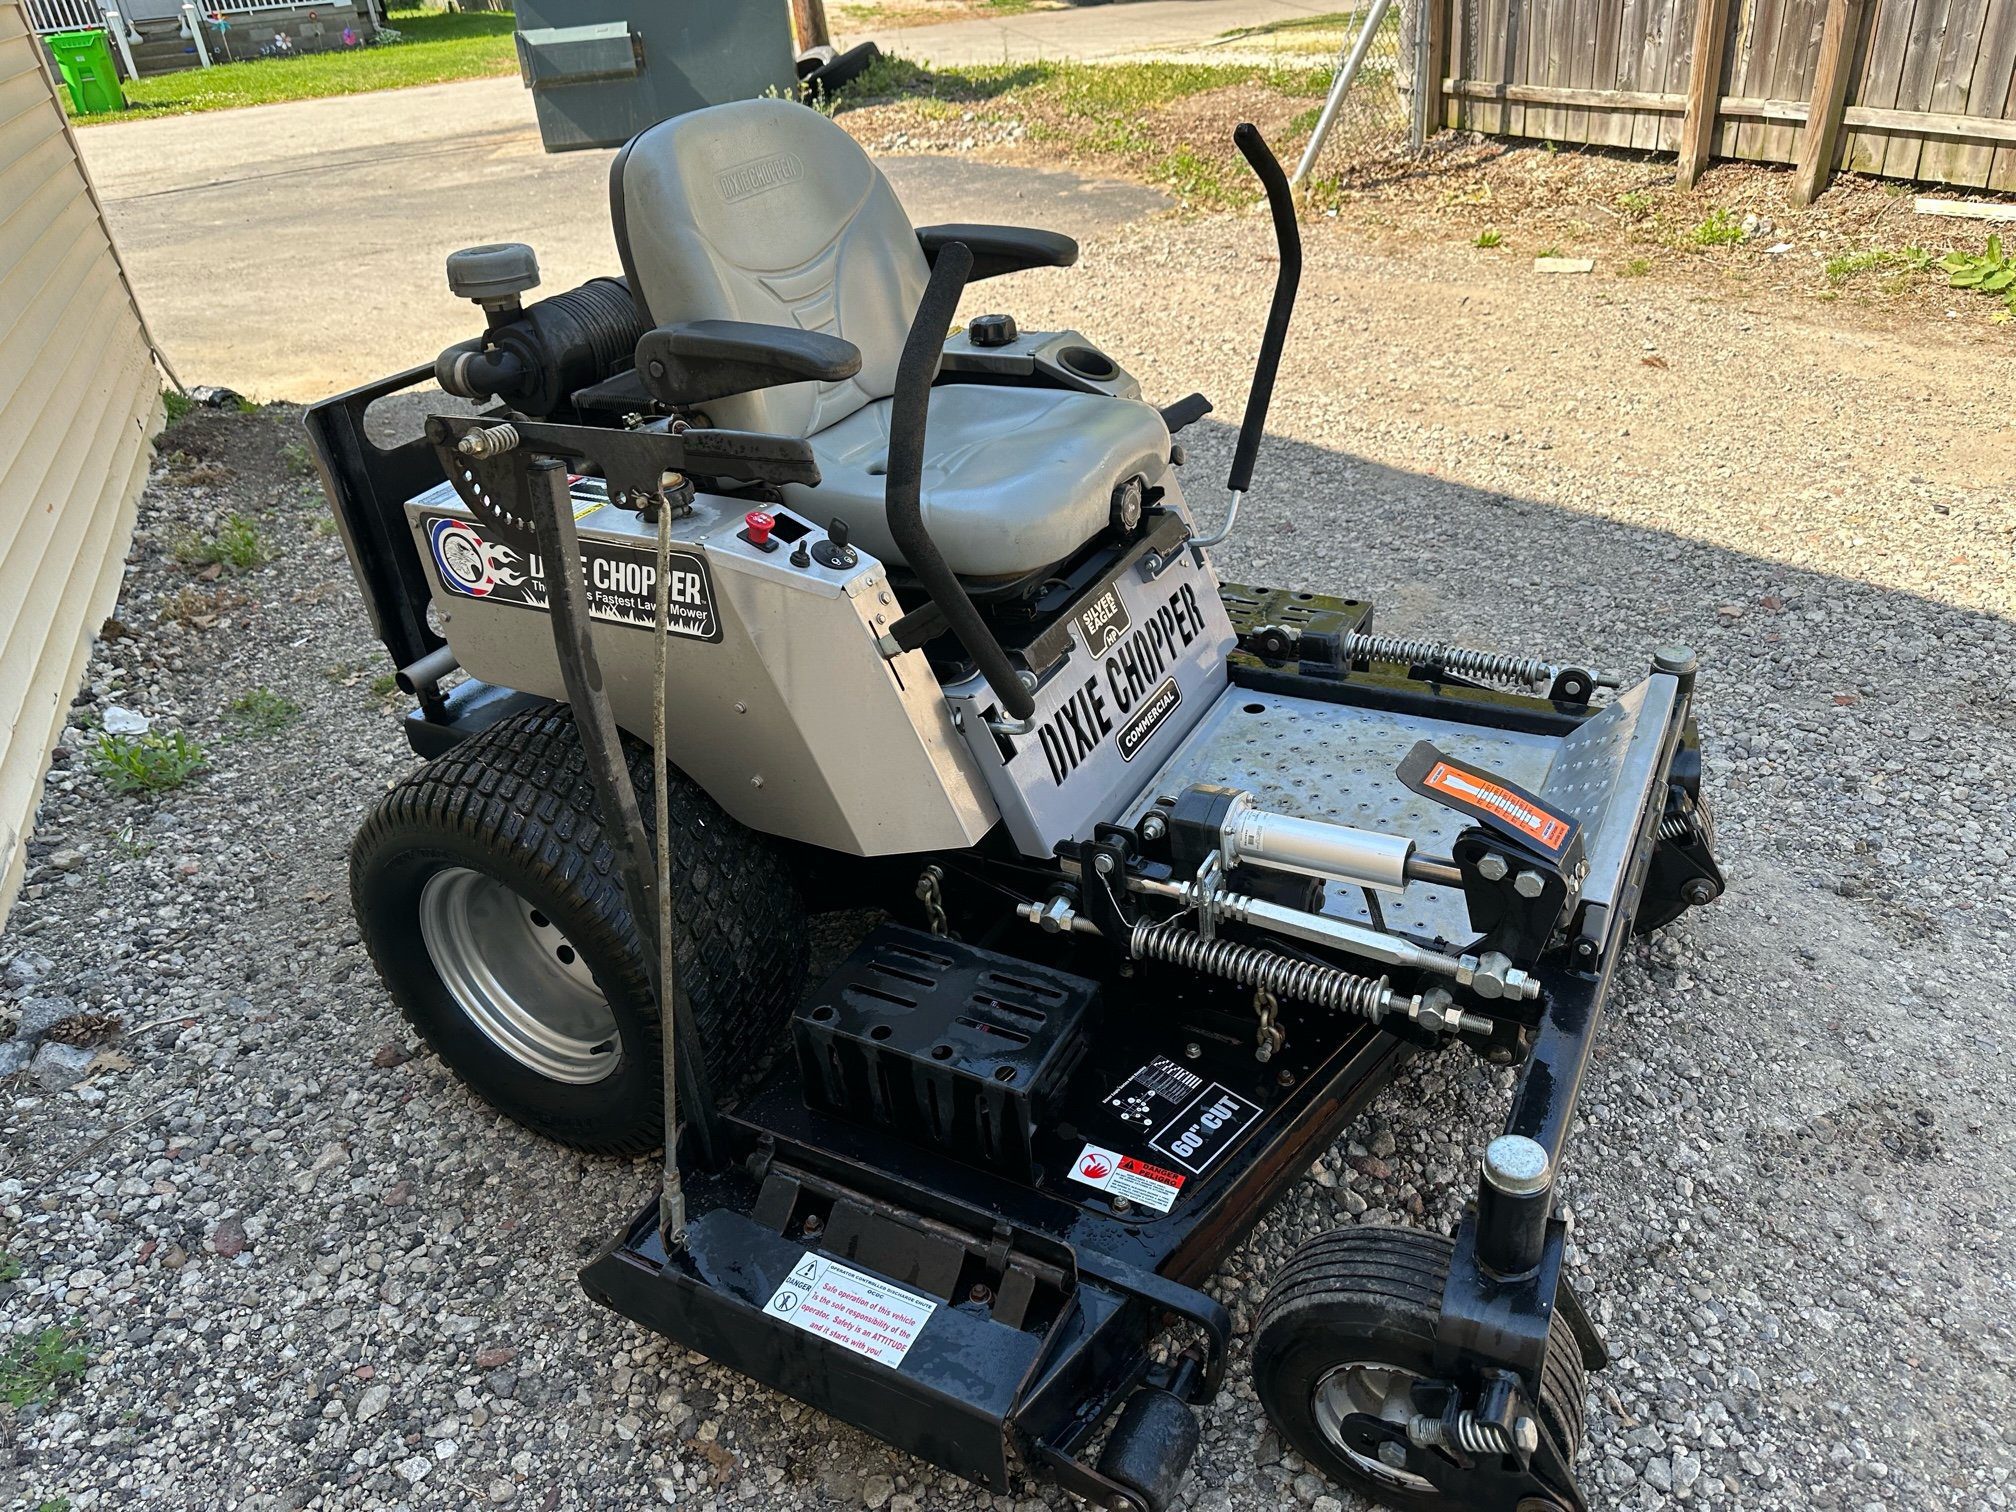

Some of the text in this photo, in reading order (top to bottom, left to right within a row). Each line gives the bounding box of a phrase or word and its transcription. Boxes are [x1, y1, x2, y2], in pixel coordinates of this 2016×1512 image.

[720, 157, 797, 199] DIXIE CHOPPER
[532, 580, 547, 592] Th
[595, 591, 635, 608] Fastest
[638, 599, 657, 611] Law
[670, 604, 708, 619] Mower
[593, 558, 701, 605] CHOPER
[1082, 592, 1115, 623] SILVER
[1087, 604, 1118, 635] EAGLE
[1106, 630, 1117, 645] HP
[1037, 582, 1206, 787] DIXIE CHOPPER
[1125, 691, 1175, 748] COMMERCIAL
[1171, 1094, 1240, 1158] 60" CUT
[1139, 1170, 1177, 1186] PELIGRO
[1143, 1164, 1179, 1180] DANGER
[785, 1276, 812, 1292] DANGER
[822, 1283, 838, 1292] Safe
[837, 1290, 869, 1307] operation
[878, 1306, 891, 1315] this
[892, 1312, 915, 1325] vehicle
[830, 1265, 932, 1310] OPERATOR CONTROLLED DISCHARGE CHUTE
[866, 1289, 884, 1299] OCDC
[800, 1303, 830, 1320] operator.
[832, 1316, 854, 1330] Safety
[872, 1332, 906, 1351] ATTITUDE
[819, 1296, 831, 1304] the
[831, 1301, 845, 1310] sole
[845, 1307, 890, 1330] responsibility
[899, 1329, 911, 1338] the
[809, 1321, 822, 1330] and
[829, 1330, 849, 1341] starts
[850, 1339, 865, 1348] with
[865, 1346, 881, 1357] you!
